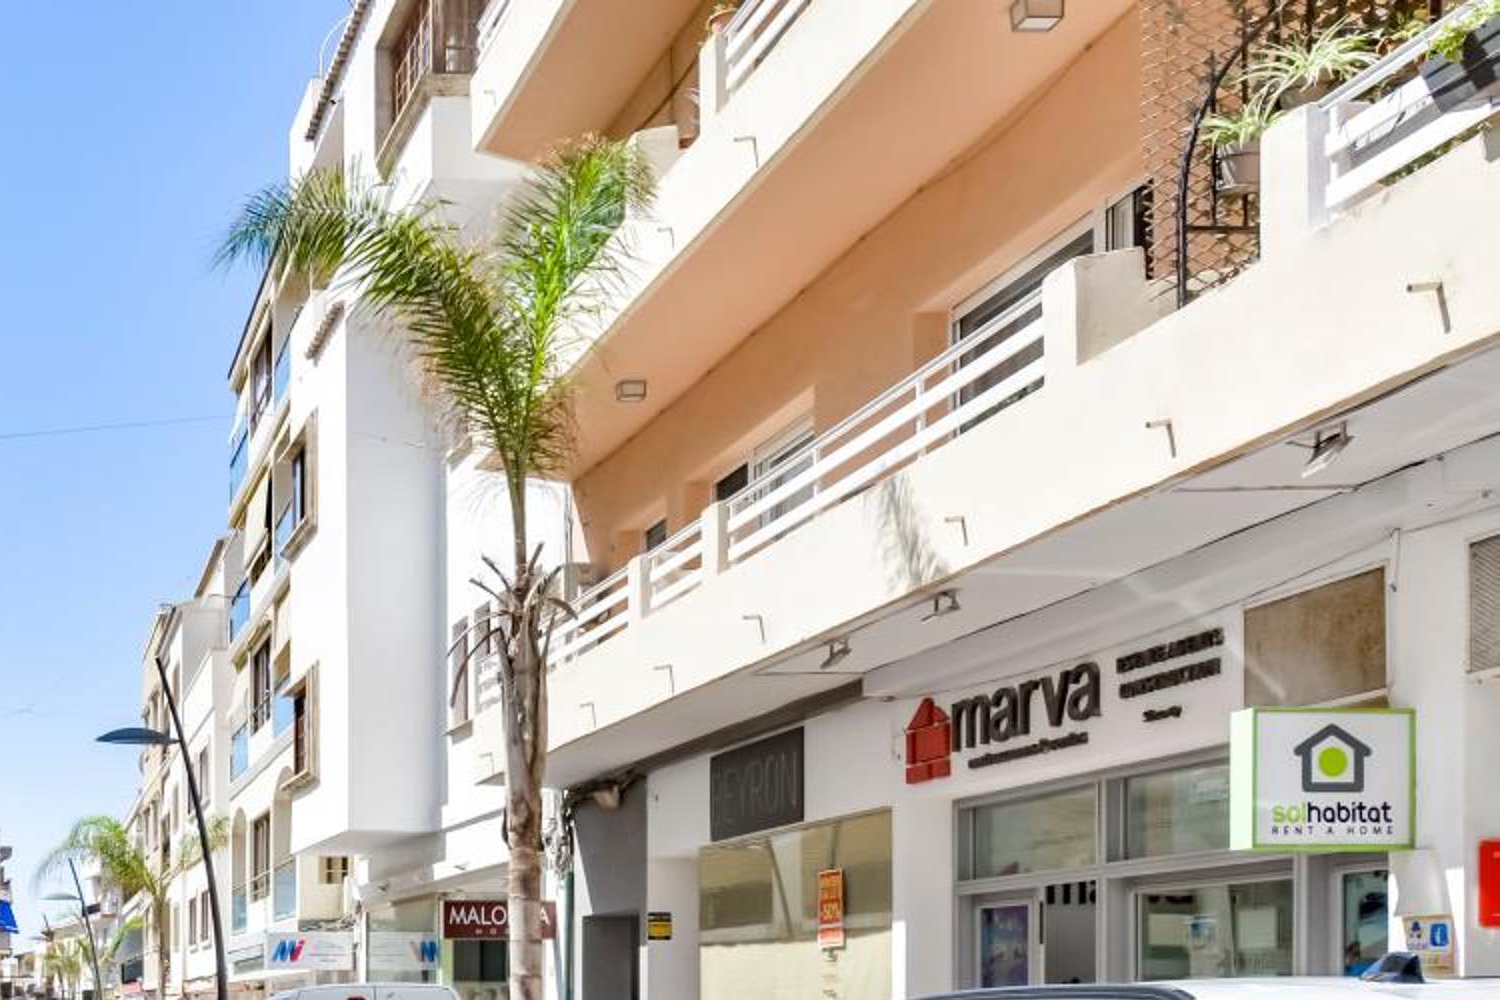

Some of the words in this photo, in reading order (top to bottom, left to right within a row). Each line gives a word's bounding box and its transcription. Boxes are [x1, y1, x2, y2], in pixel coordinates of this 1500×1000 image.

[952, 661, 1102, 752] marva
[1272, 801, 1393, 823] solhabitat
[1271, 826, 1313, 835] RENT
[1327, 826, 1334, 835] A
[1348, 826, 1393, 835] HOME
[449, 906, 549, 926] MALOA
